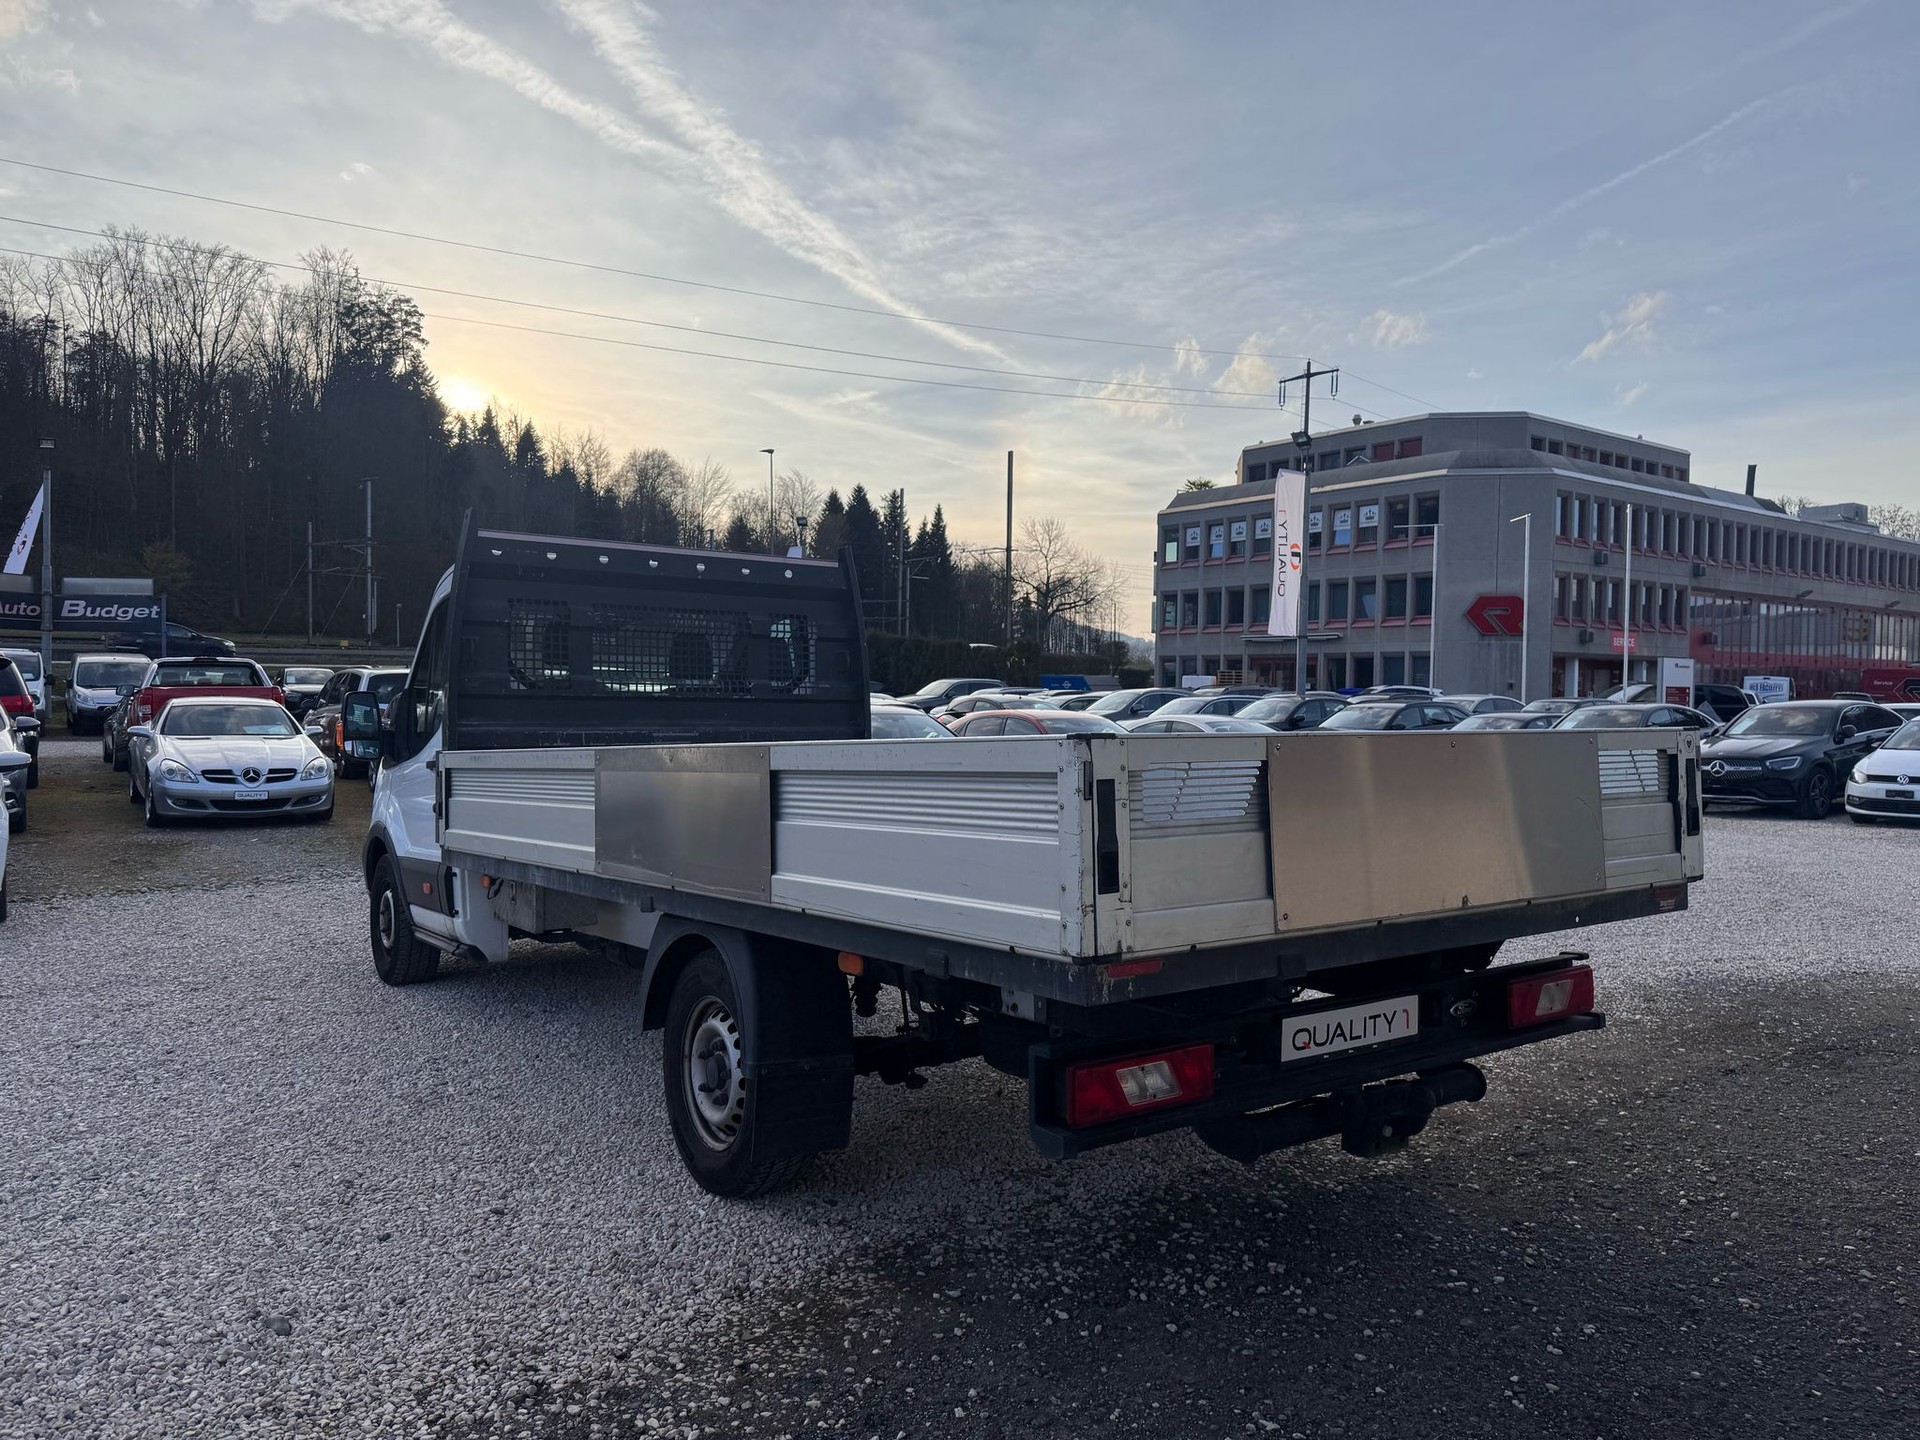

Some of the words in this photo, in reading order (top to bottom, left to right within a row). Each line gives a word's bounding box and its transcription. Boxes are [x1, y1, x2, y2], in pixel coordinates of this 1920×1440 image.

[61, 600, 160, 621] Budget
[1292, 1010, 1397, 1051] QUALITY
[1402, 1008, 1410, 1029] 1
